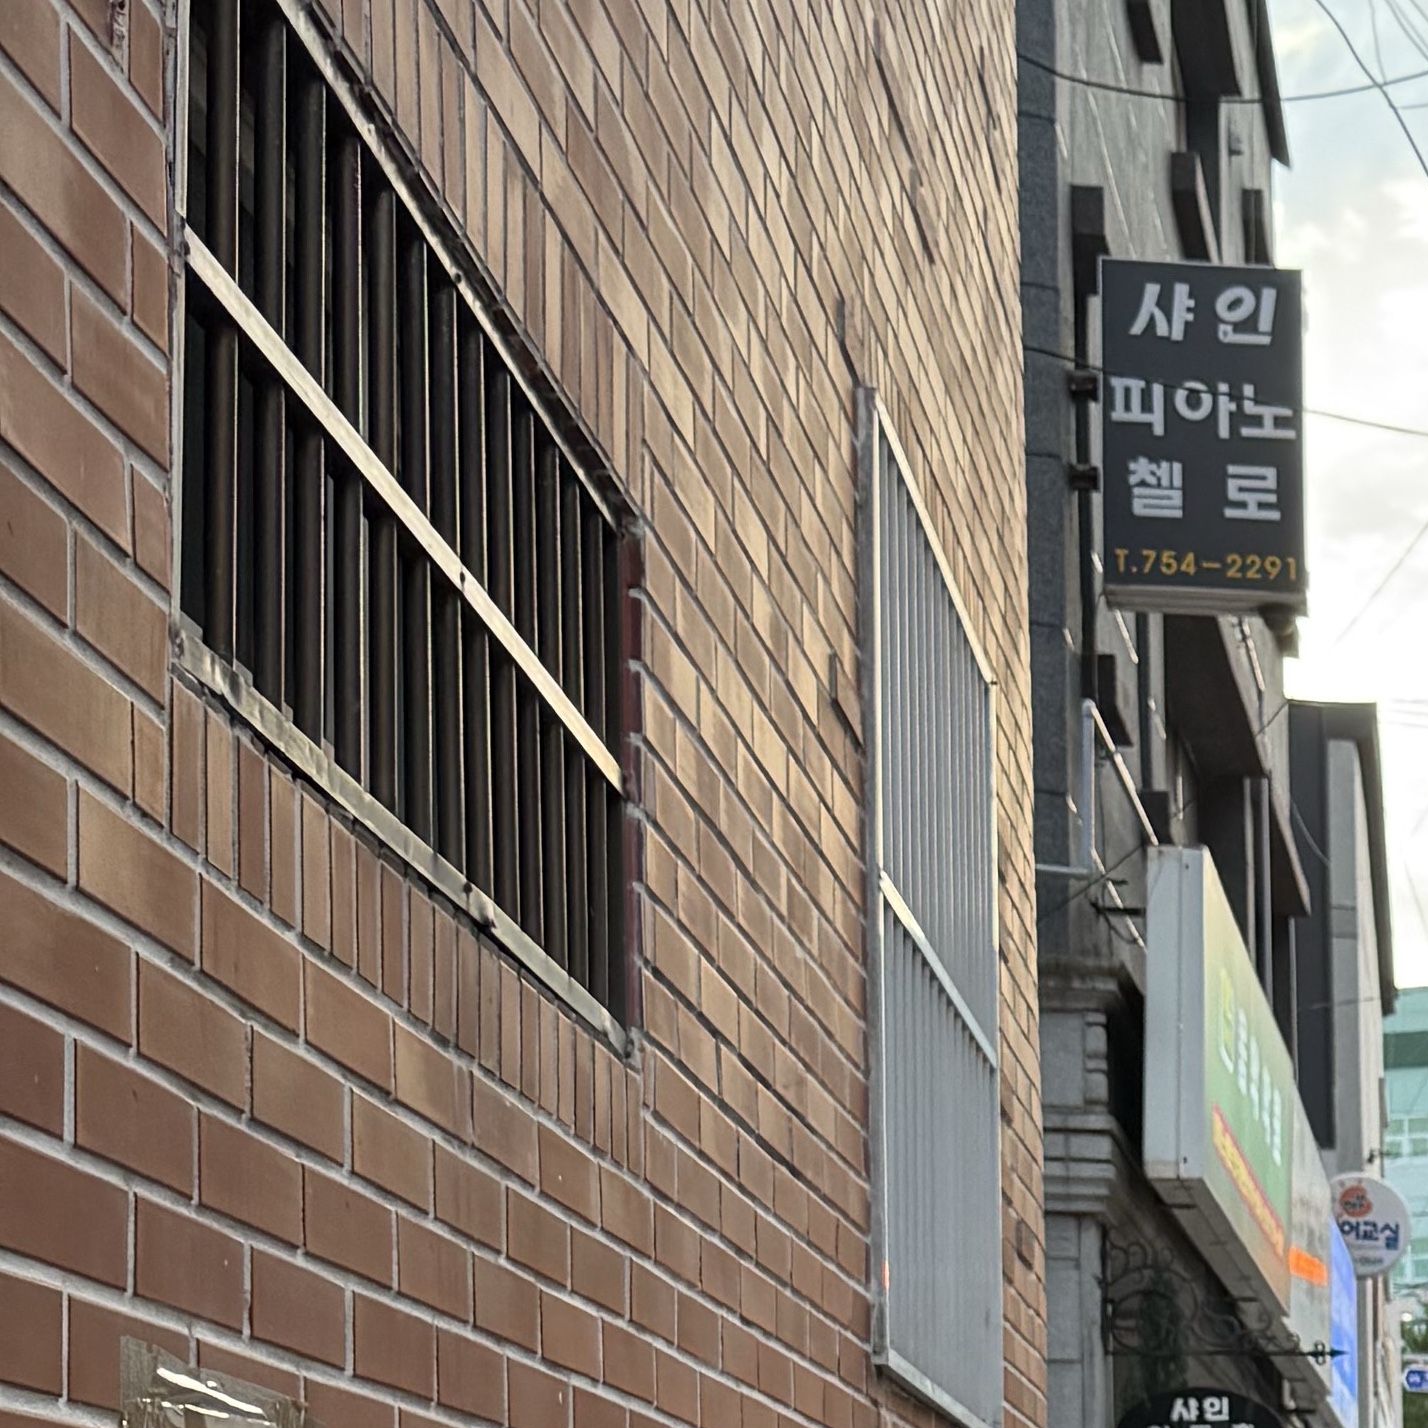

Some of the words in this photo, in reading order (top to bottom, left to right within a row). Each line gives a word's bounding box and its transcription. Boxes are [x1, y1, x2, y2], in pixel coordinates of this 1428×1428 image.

[1129, 282, 1277, 345] 샤인
[1110, 376, 1297, 439] 피아노
[1127, 455, 1282, 521] 첼로
[1114, 547, 1297, 581] T.754-2291
[1337, 1220, 1400, 1251] 어교실
[1169, 1395, 1230, 1422] 샤인
